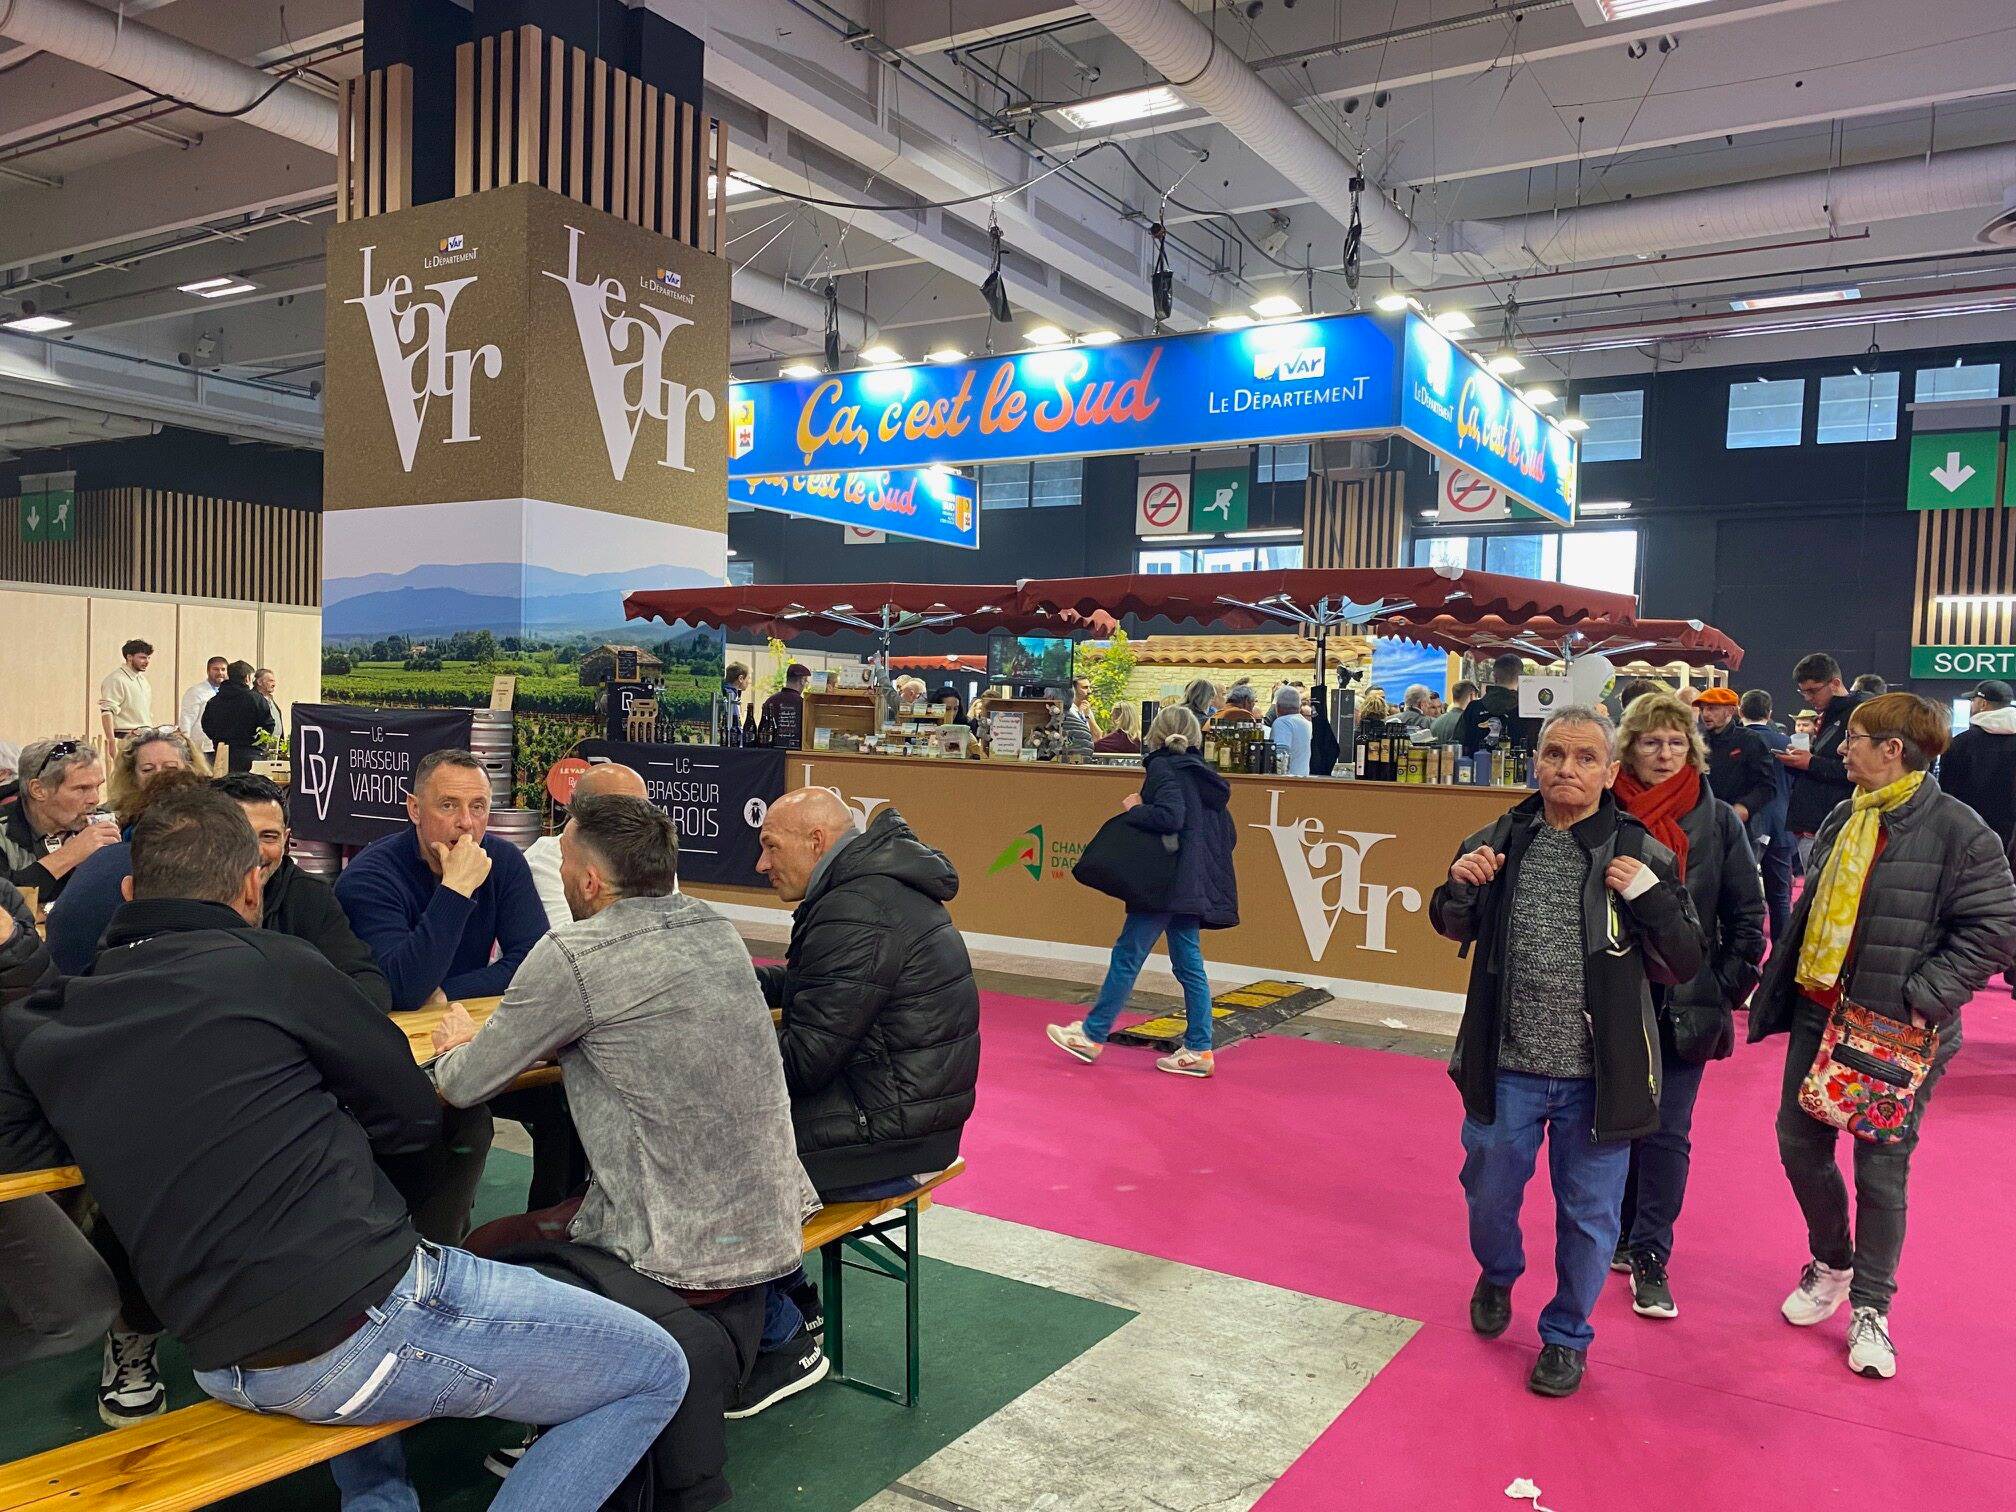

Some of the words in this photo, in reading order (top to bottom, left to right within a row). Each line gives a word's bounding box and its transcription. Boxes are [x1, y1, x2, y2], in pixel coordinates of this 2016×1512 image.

[359, 245, 413, 316] Le
[564, 224, 627, 320] Le
[344, 276, 503, 472] Var
[542, 270, 716, 481] Var
[797, 379, 869, 466] Ça,
[878, 370, 976, 442] c'est
[979, 361, 1027, 435] le
[1033, 346, 1175, 433] Sud
[843, 471, 865, 503] le
[868, 470, 918, 516] Sud
[1934, 652, 2016, 673] SORT
[371, 726, 384, 743] LE
[350, 749, 410, 771] BRASSEUR
[675, 758, 691, 774] LE
[349, 773, 411, 805] VAROIS
[647, 780, 719, 803] BRASSEUR
[653, 805, 719, 837] ROIS
[1266, 789, 1325, 847] Le
[1248, 823, 1422, 962] Var
